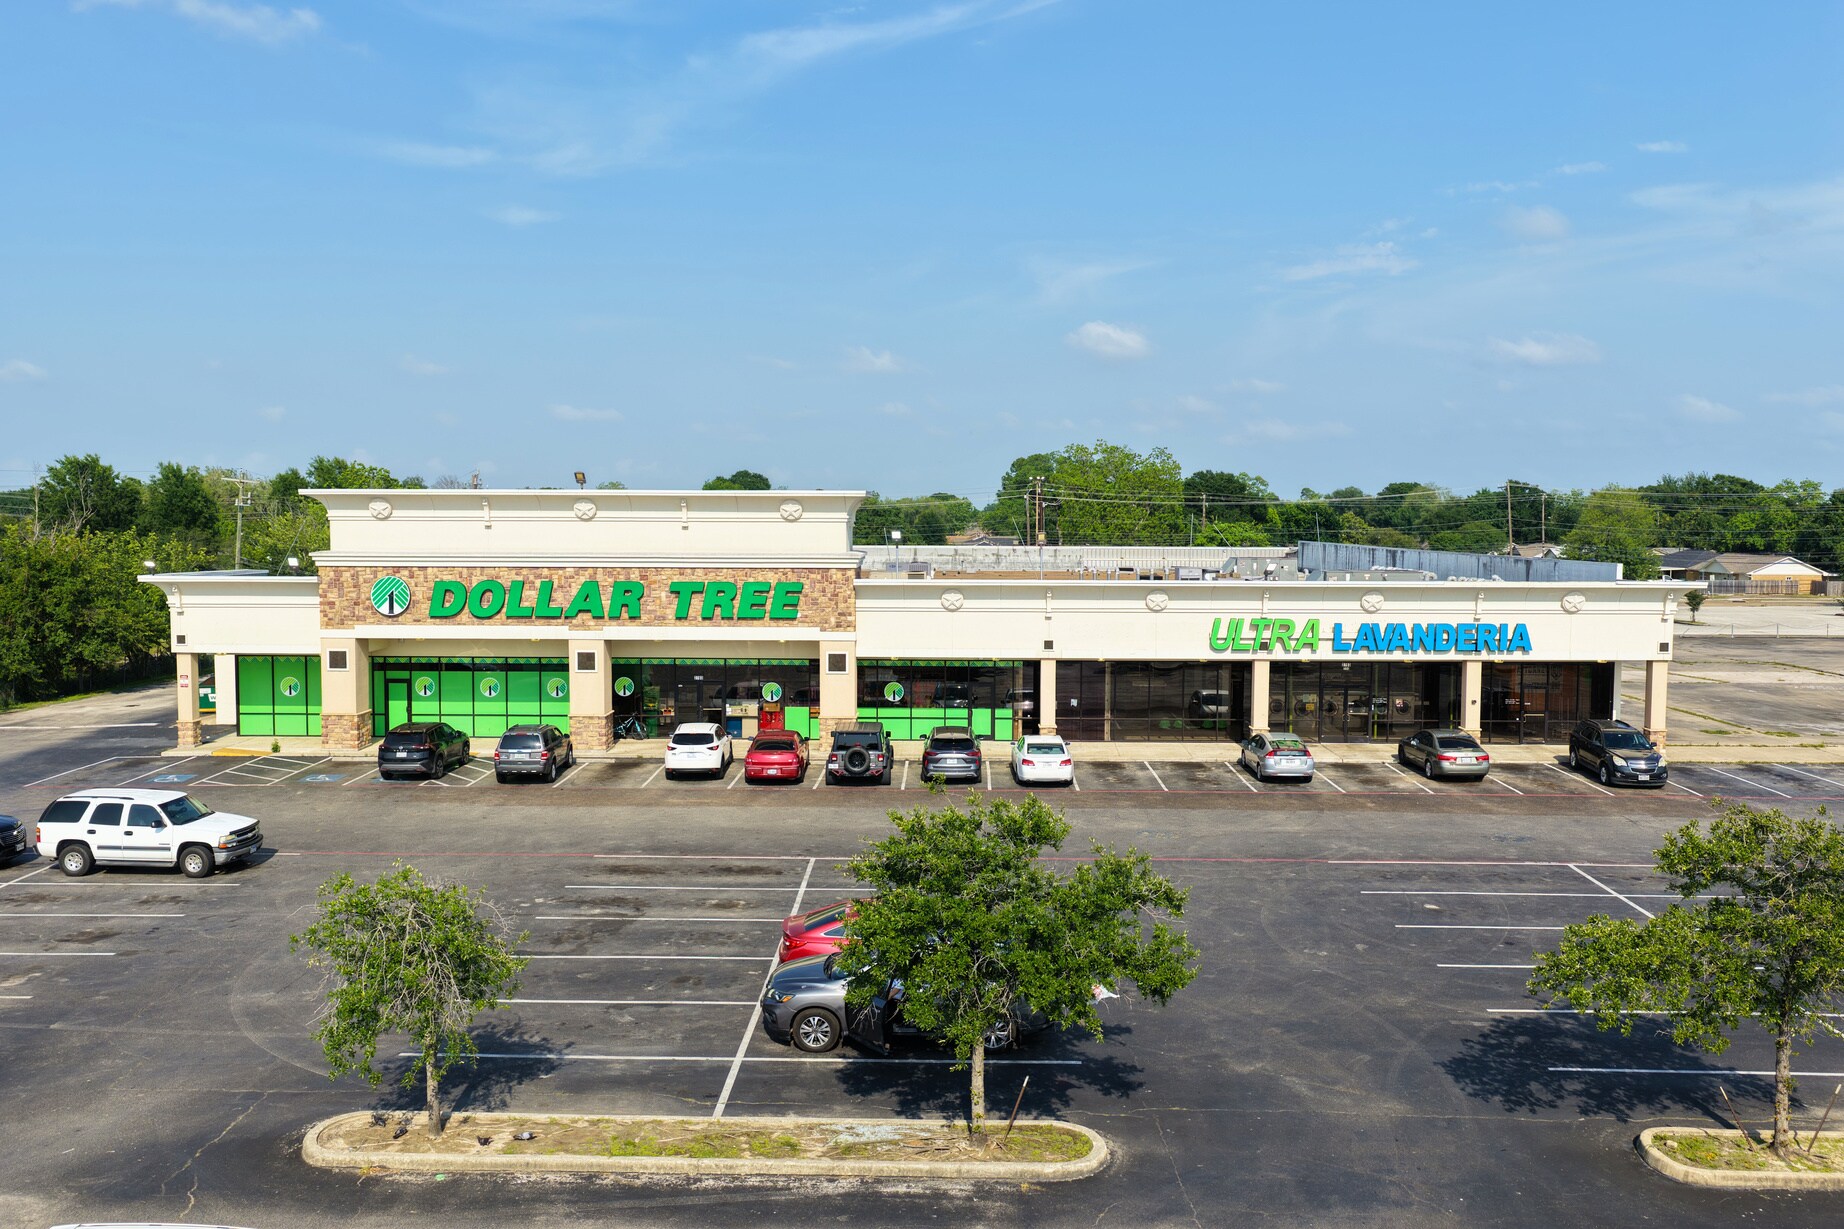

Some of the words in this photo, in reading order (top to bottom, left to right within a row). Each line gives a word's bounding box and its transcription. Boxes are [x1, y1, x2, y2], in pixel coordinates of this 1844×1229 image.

[428, 580, 645, 618] DOLLAR
[669, 581, 804, 619] TREE
[1209, 618, 1320, 651] ULTRA
[1332, 622, 1533, 653] LAVANDERIA
